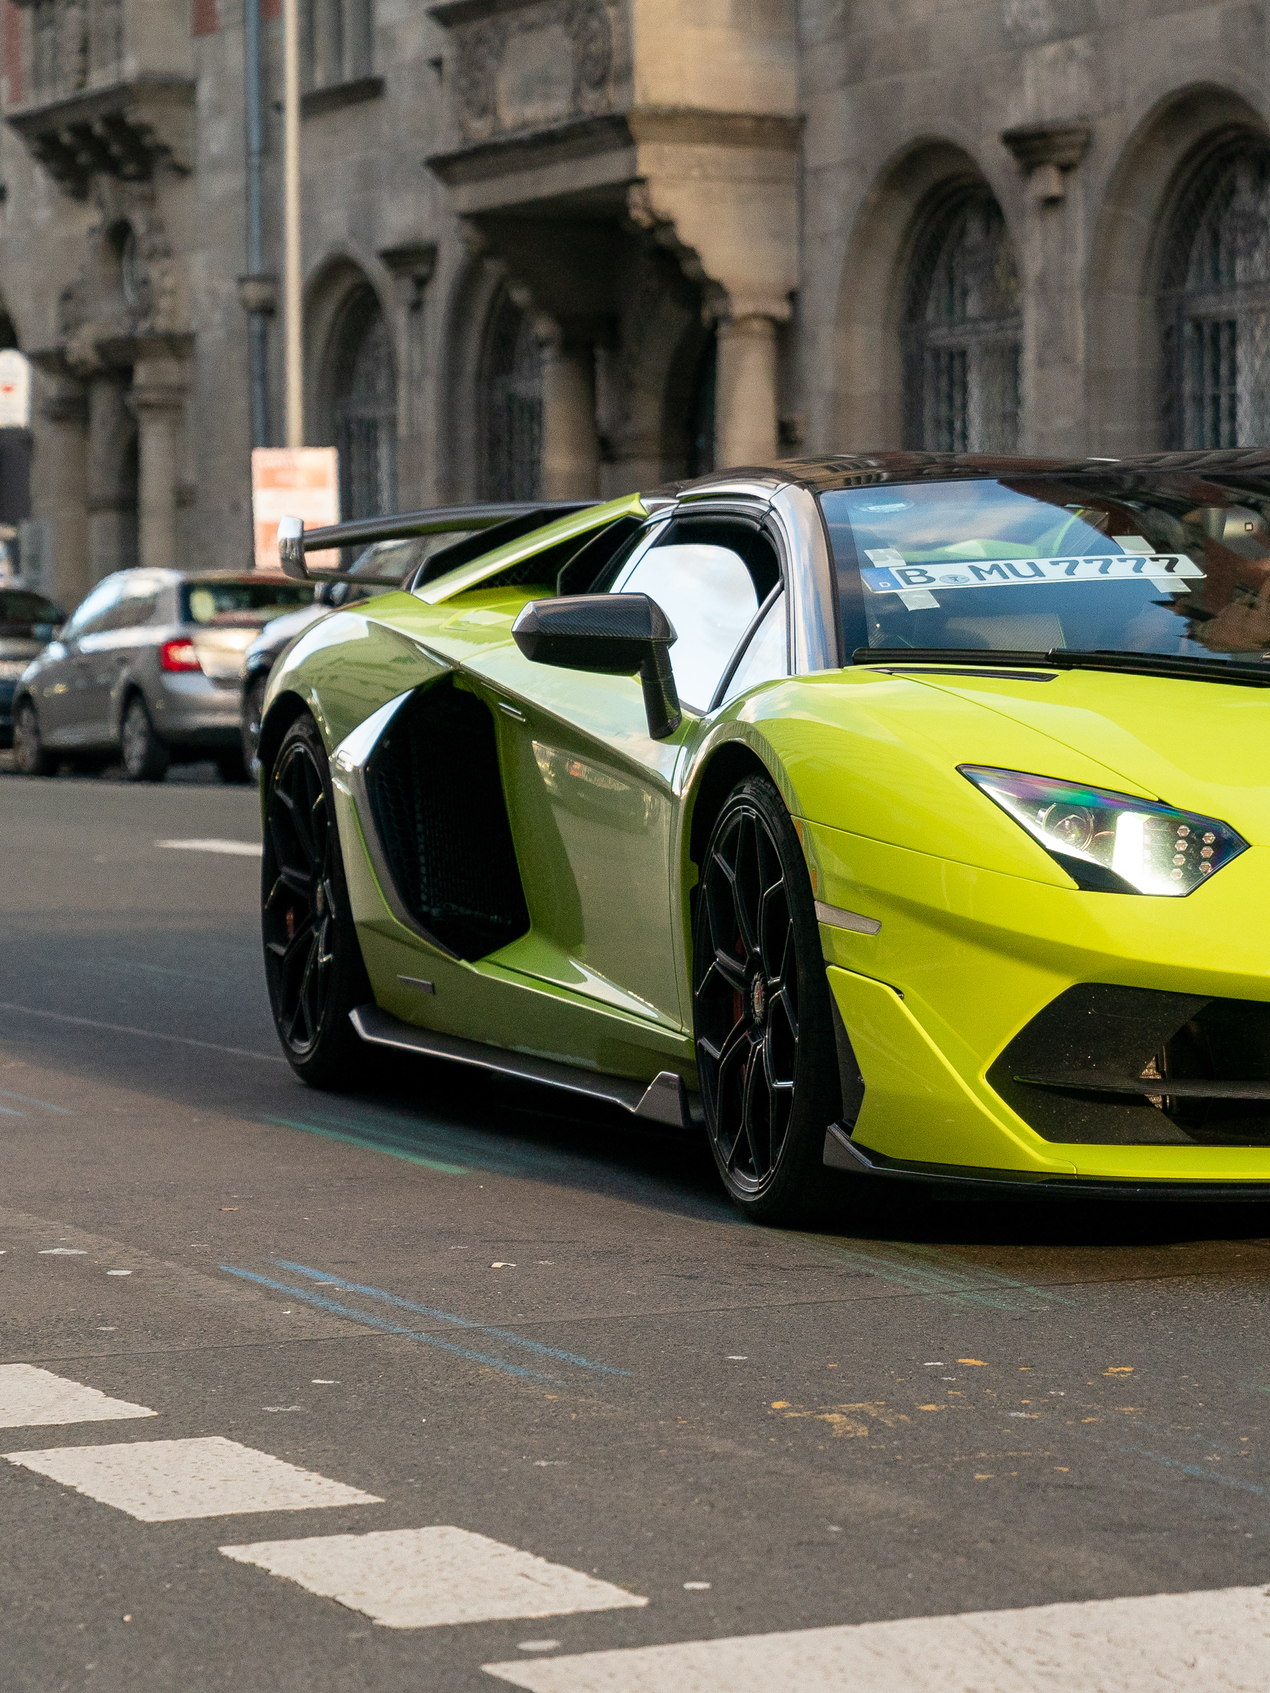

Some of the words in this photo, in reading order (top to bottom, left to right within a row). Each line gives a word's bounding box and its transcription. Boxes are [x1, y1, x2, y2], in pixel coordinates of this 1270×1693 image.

[895, 568, 936, 586] B
[968, 561, 1045, 581] MU
[1050, 557, 1179, 576] 7777
